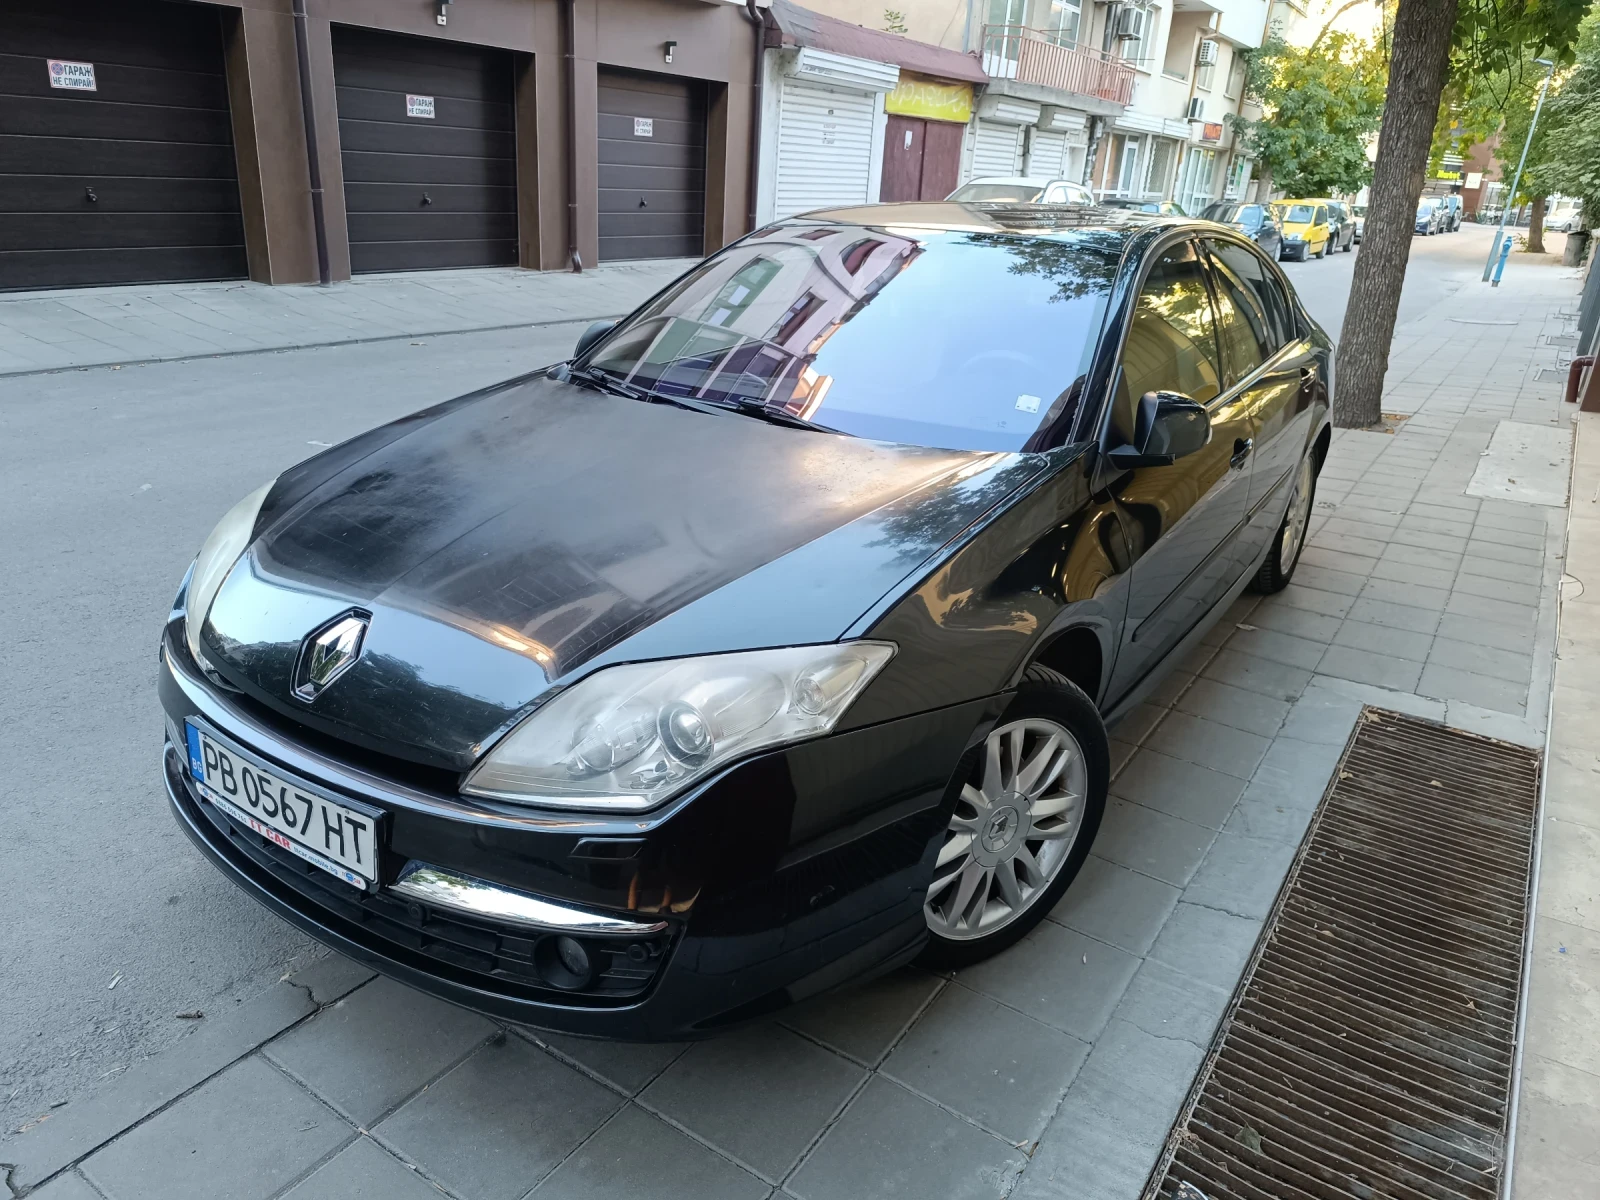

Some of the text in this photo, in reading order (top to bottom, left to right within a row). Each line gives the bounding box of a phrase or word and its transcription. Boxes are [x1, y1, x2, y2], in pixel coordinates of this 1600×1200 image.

[64, 65, 93, 77] ГАРАЖ
[53, 76, 93, 87] НЕ СПИРАЙ!
[416, 98, 433, 107] ГАРАЖ
[192, 757, 203, 773] BG
[241, 766, 314, 836] 0567
[248, 817, 291, 850] TT CAR
